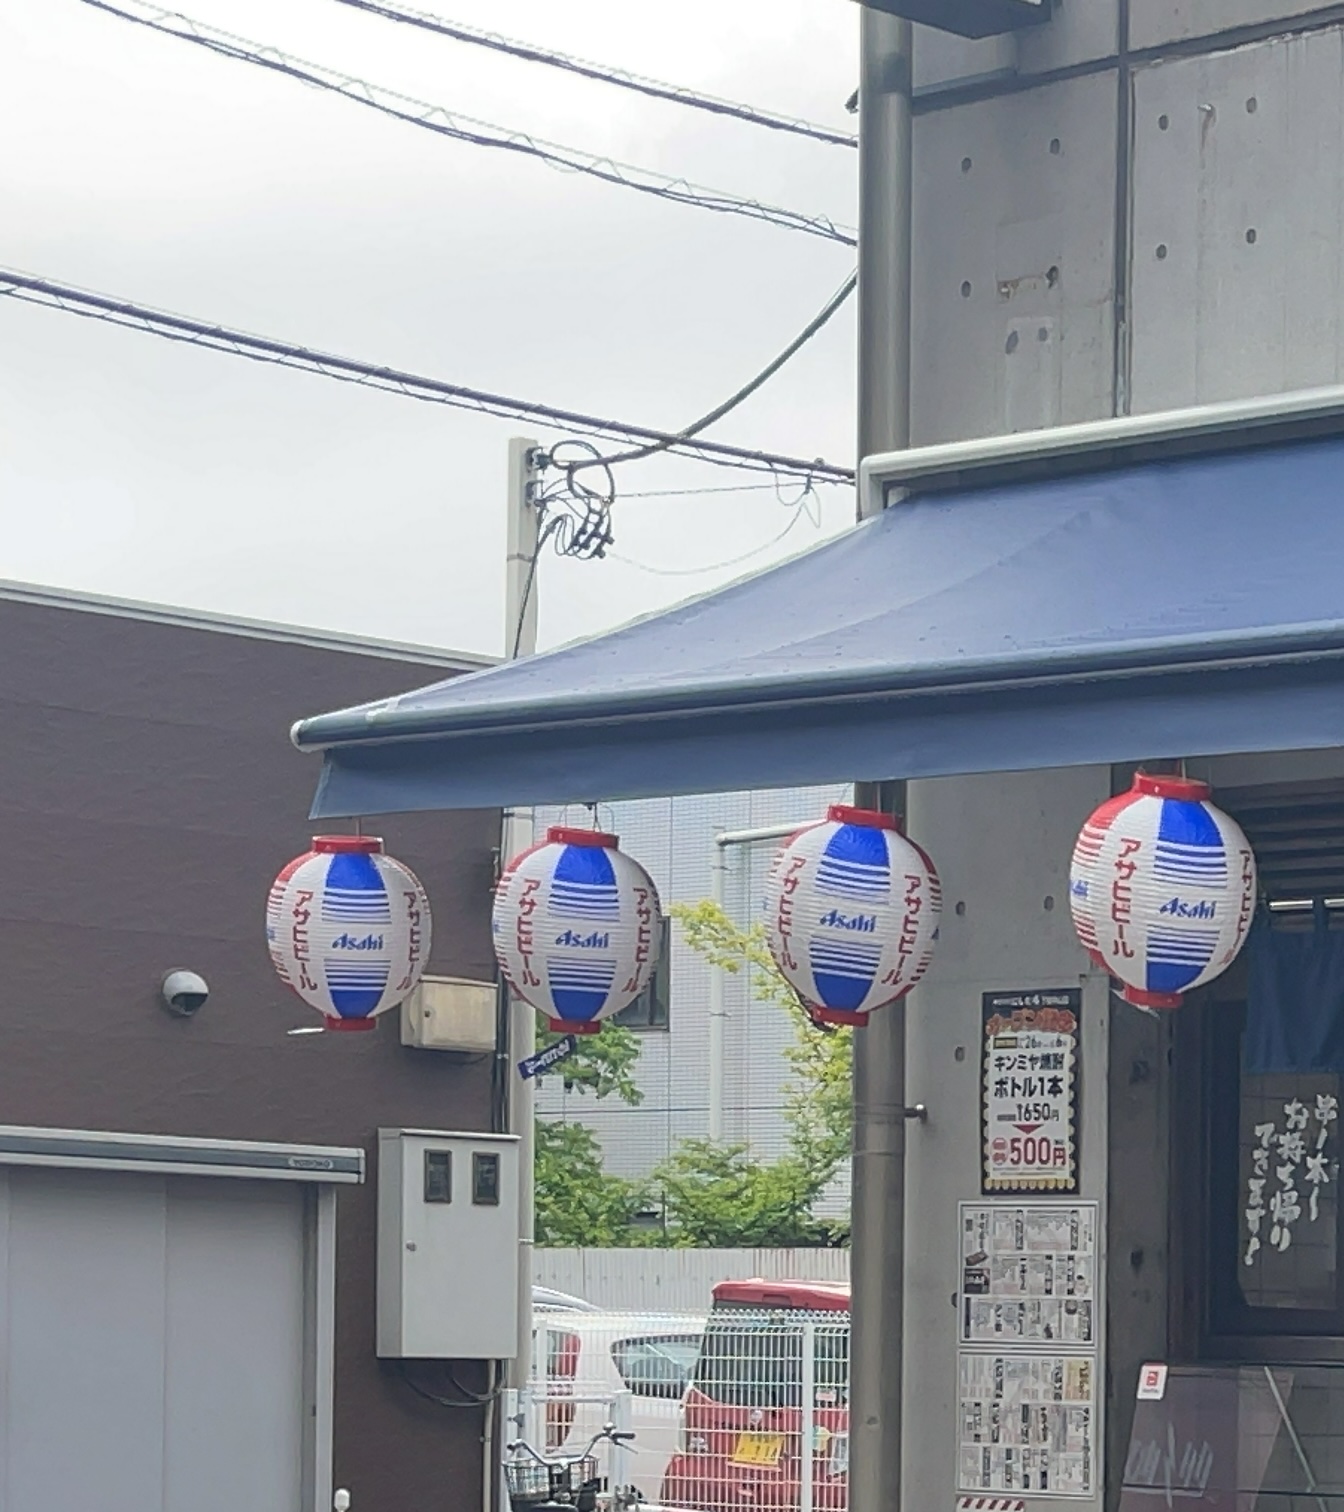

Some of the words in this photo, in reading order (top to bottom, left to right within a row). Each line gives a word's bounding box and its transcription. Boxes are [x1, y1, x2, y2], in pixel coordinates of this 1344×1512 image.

[292, 890, 318, 990] アサヒビール
[332, 933, 383, 950] Asahi
[396, 892, 421, 991] アサヒビール
[517, 879, 540, 987] アサヒビール
[555, 930, 609, 948] Asahi
[622, 888, 650, 992] アサヒビール
[778, 856, 807, 970] アサヒビール
[819, 909, 877, 932] Asahi
[881, 875, 922, 985] アサヒビール
[1111, 838, 1142, 958] アサヒビール
[1159, 897, 1217, 920] Asahi
[994, 1075, 1064, 1098] ボトル1本
[1010, 1137, 1066, 1166] 500円
[1270, 1097, 1309, 1252] お持ち帰り
